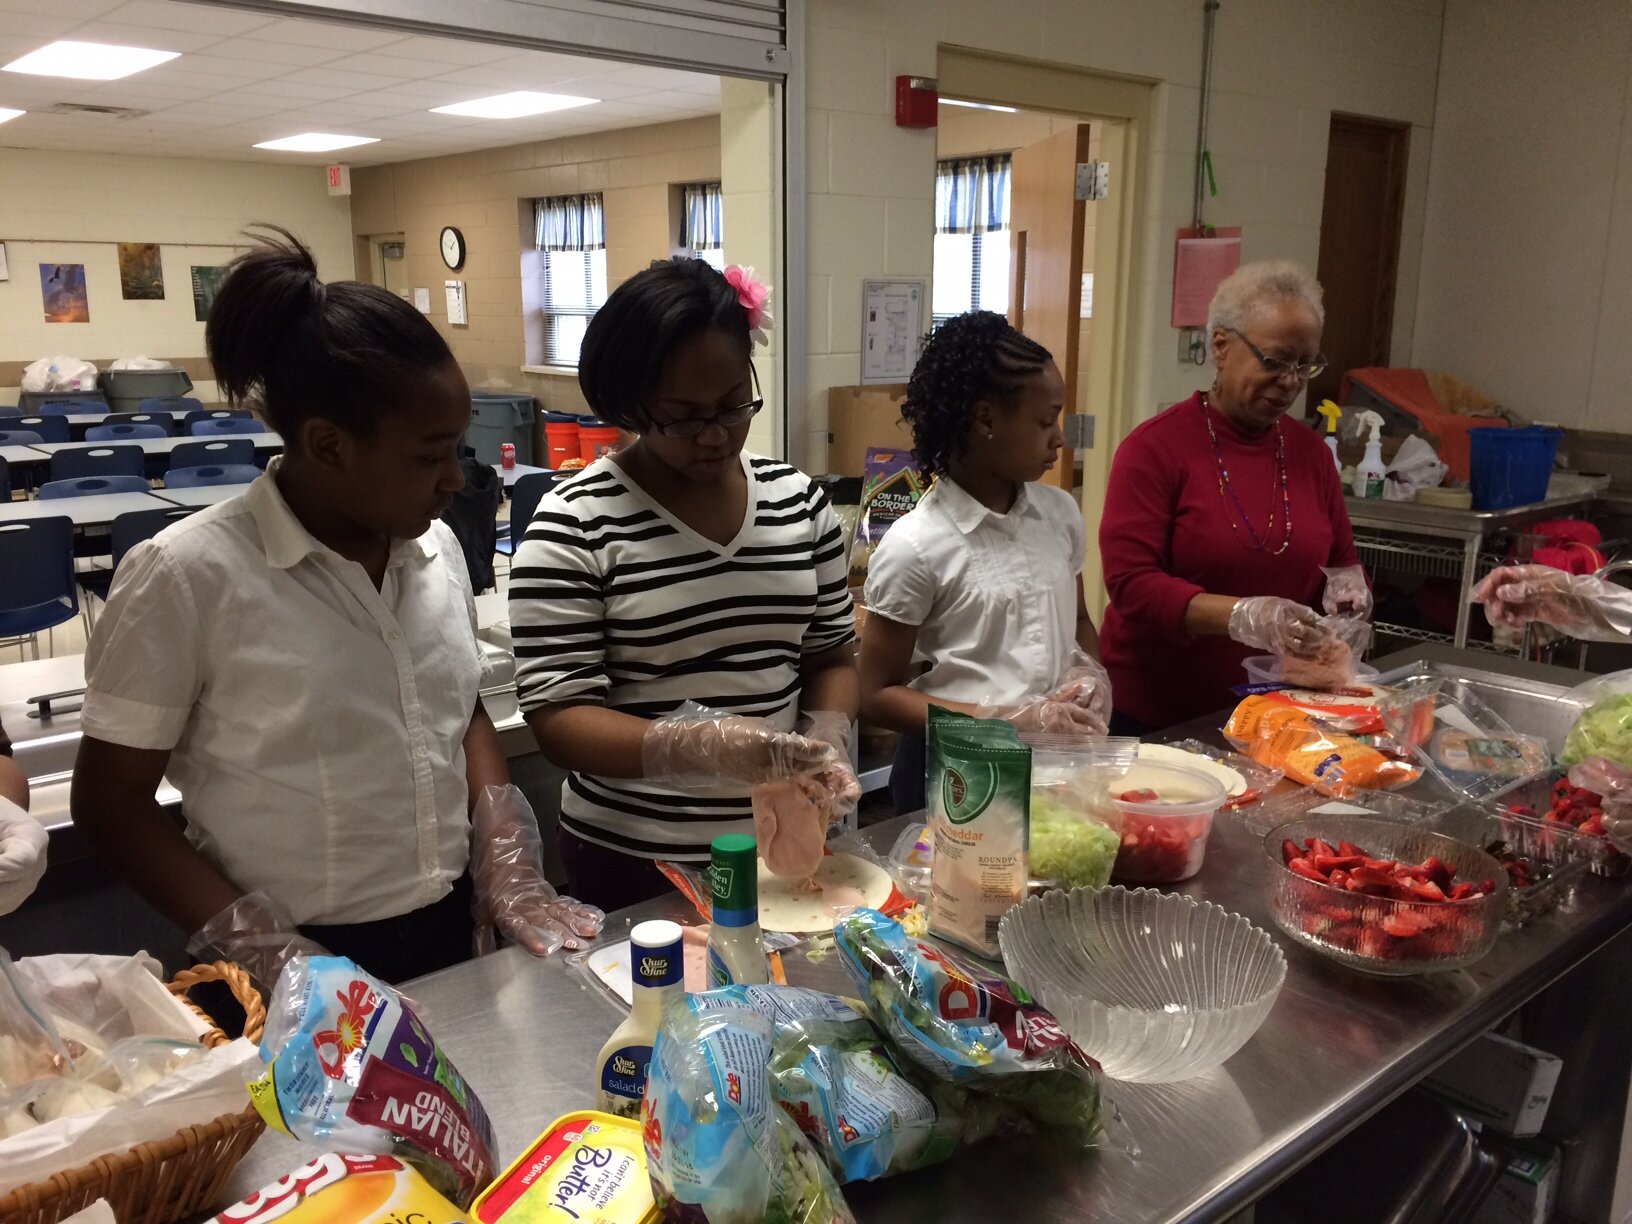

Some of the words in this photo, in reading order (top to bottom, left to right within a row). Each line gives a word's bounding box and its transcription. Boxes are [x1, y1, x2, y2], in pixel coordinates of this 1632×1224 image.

[871, 499, 915, 512] BORDER
[877, 492, 891, 500] ON
[893, 494, 911, 503] THE
[640, 957, 668, 972] Shur
[313, 980, 377, 1080] Dole
[608, 1080, 637, 1094] salad
[725, 1072, 739, 1103] Dole
[415, 1091, 470, 1144] BLEND
[381, 1096, 484, 1188] ITALIAN
[521, 1154, 552, 1185] original
[549, 1145, 612, 1219] Butter!
[597, 1169, 611, 1184] it's
[615, 1160, 630, 1181] can't
[587, 1183, 601, 1201] not
[595, 1180, 621, 1210] believe
